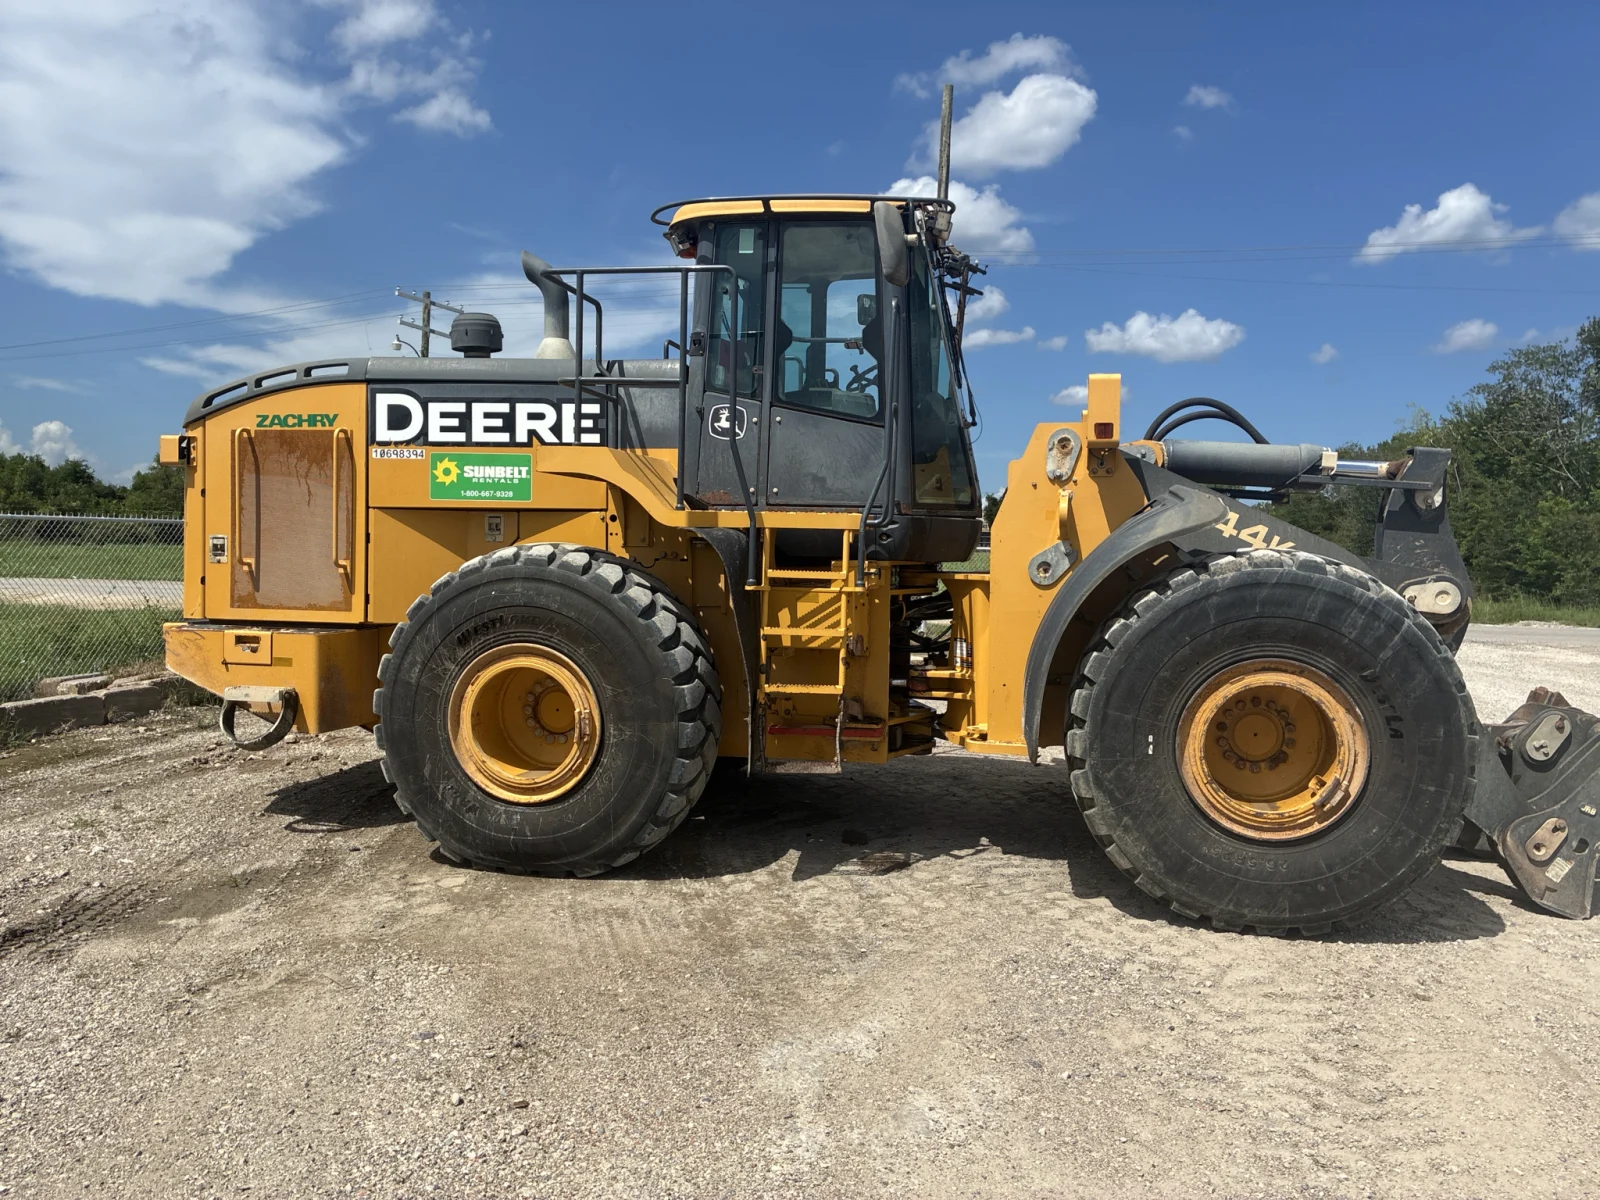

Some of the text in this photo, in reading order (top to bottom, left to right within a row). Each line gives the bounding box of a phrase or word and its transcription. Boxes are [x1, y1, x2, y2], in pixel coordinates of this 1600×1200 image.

[256, 413, 339, 428] ZACHRY
[375, 393, 601, 443] DEERE
[372, 448, 425, 459] 10698394
[463, 465, 529, 479] SUNBELT
[460, 490, 513, 498] 1-800-667-9328
[1580, 804, 1597, 816] JRB
